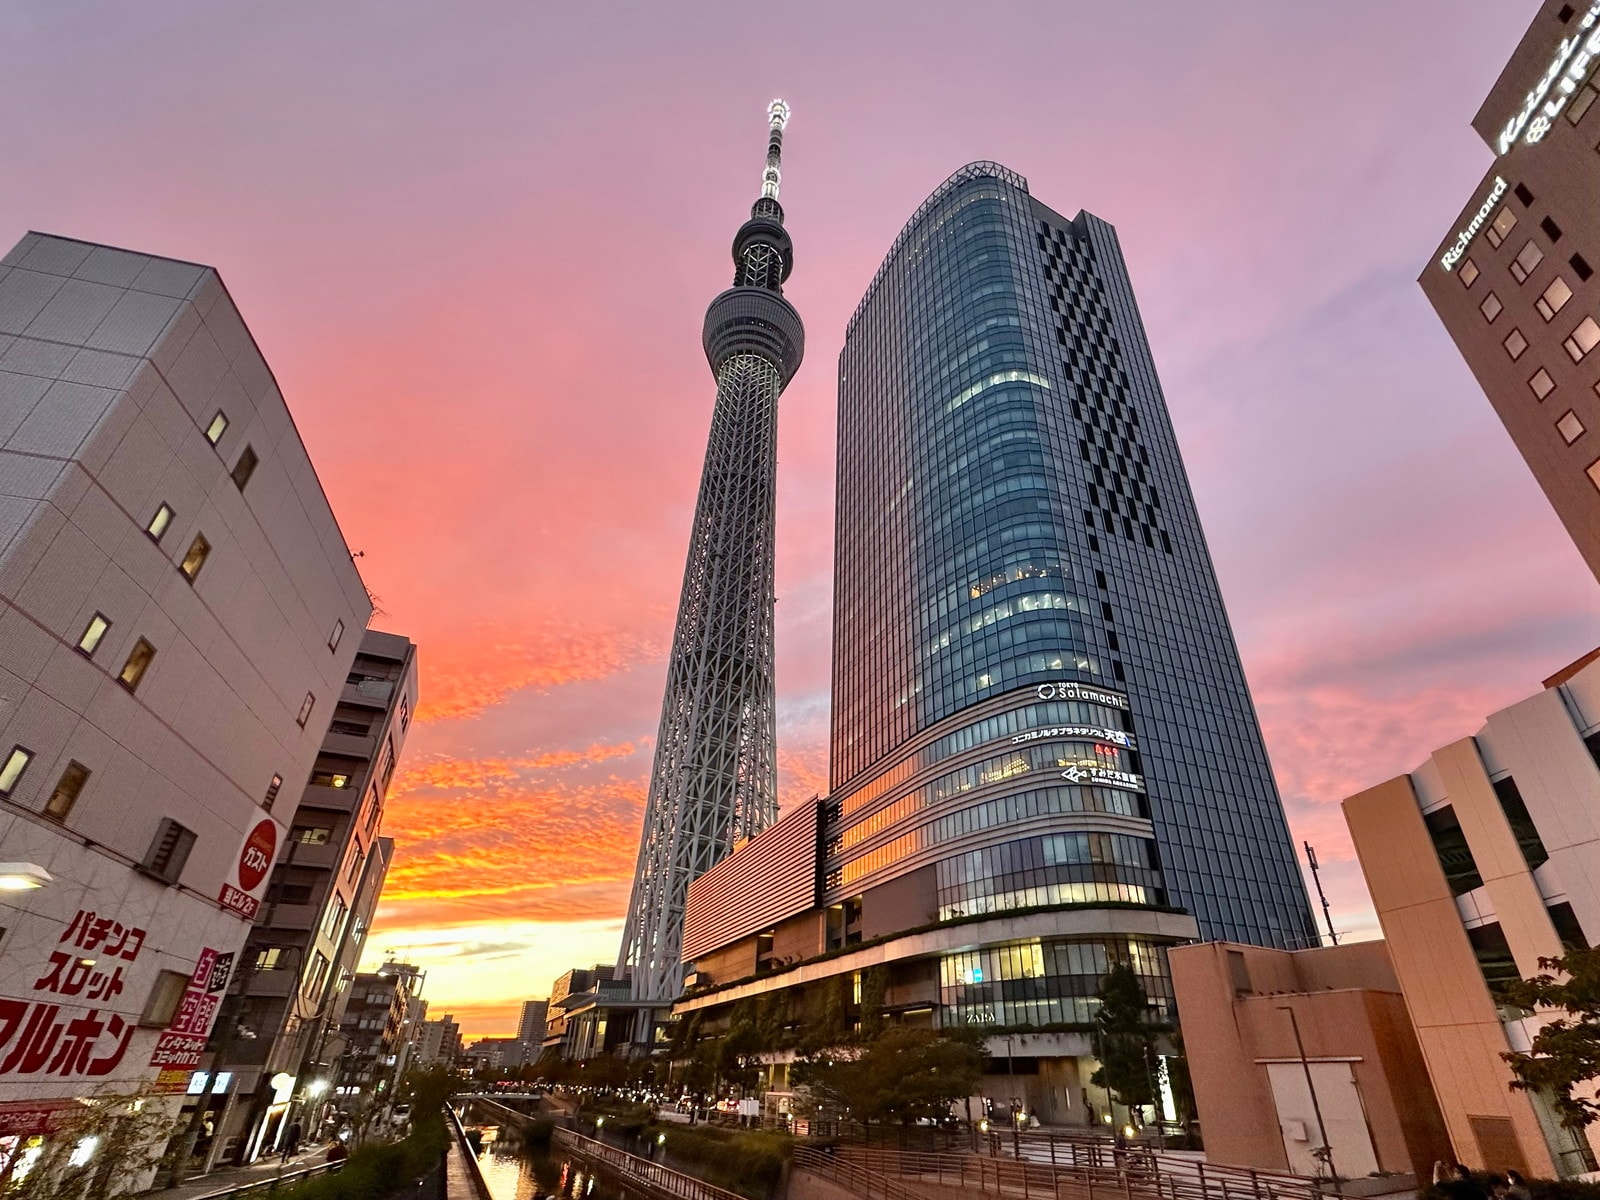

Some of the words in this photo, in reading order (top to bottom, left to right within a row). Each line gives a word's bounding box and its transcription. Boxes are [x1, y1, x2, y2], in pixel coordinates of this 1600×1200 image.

[1499, 34, 1581, 155] Keisei
[1441, 175, 1508, 272] Richmond
[1060, 687, 1123, 707] Solamachi
[243, 846, 267, 872] ガスト
[59, 910, 147, 961] パチンコ
[33, 951, 123, 1001] スロット
[966, 1012, 995, 1024] ZARA
